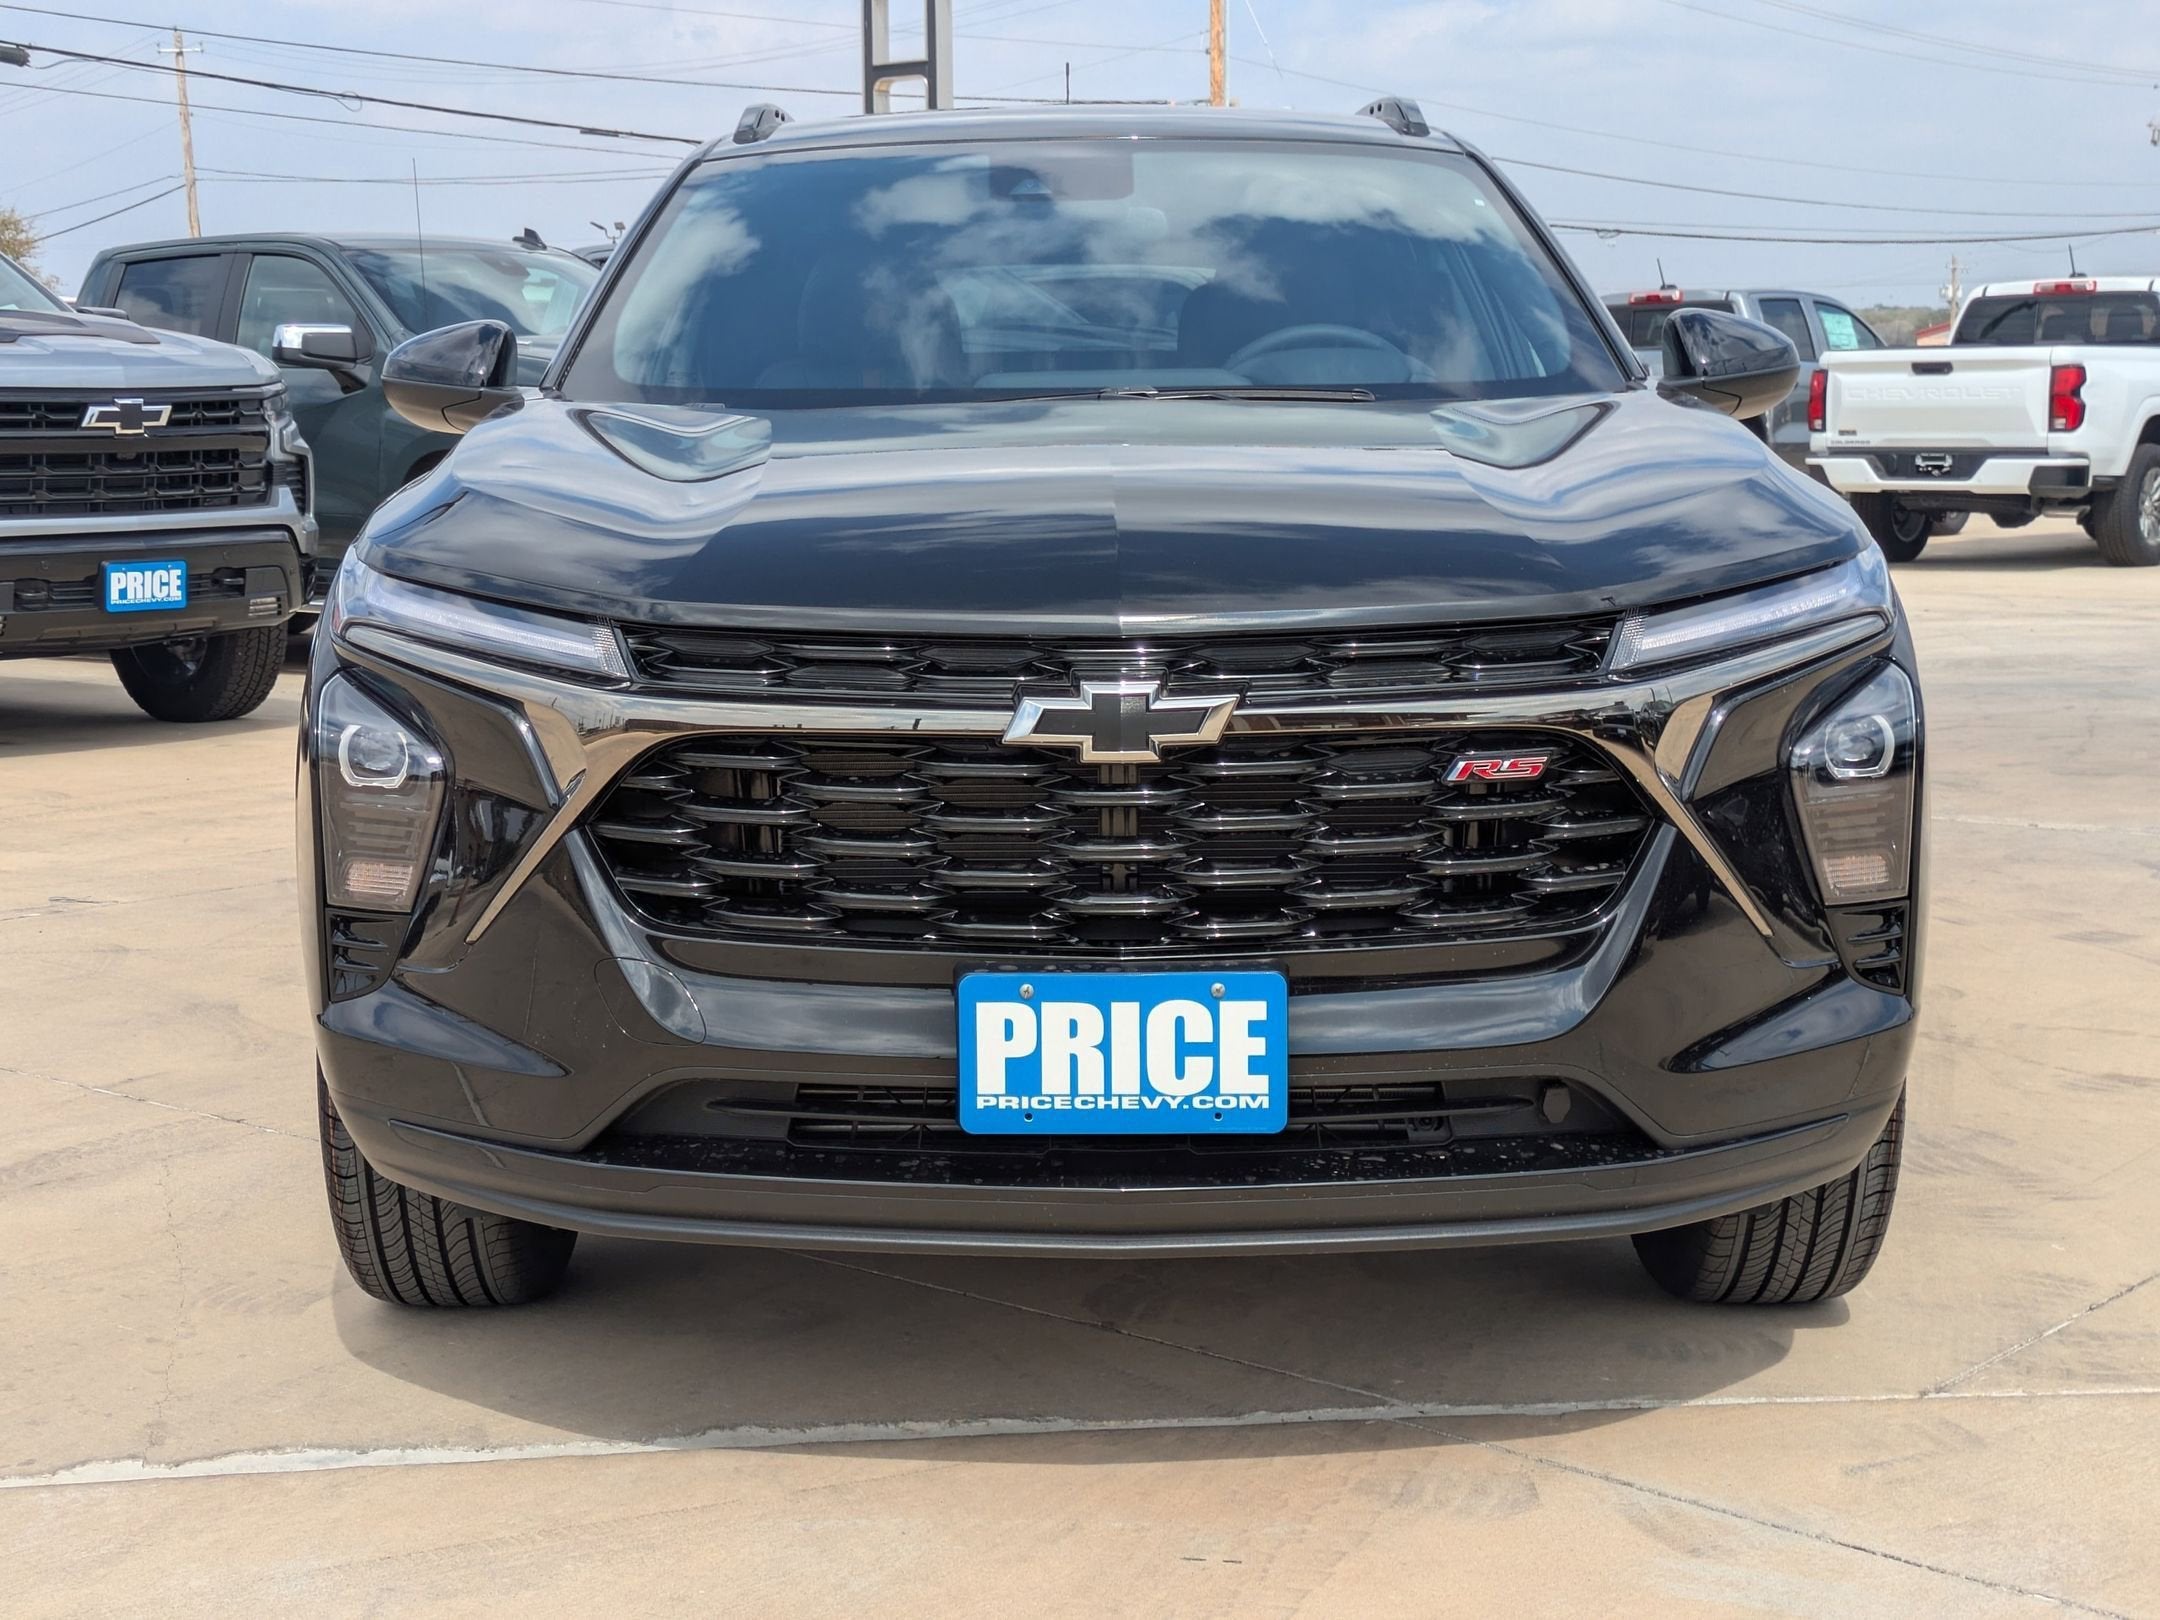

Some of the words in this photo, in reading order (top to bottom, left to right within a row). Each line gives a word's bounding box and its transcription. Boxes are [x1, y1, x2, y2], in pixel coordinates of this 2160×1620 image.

[1846, 387, 2021, 400] CHEVROLET
[111, 569, 182, 600] PRICE
[1447, 757, 1548, 781] RS
[976, 1000, 1269, 1095] PRICE
[976, 1096, 1269, 1109] PRICECHEVY.COM
